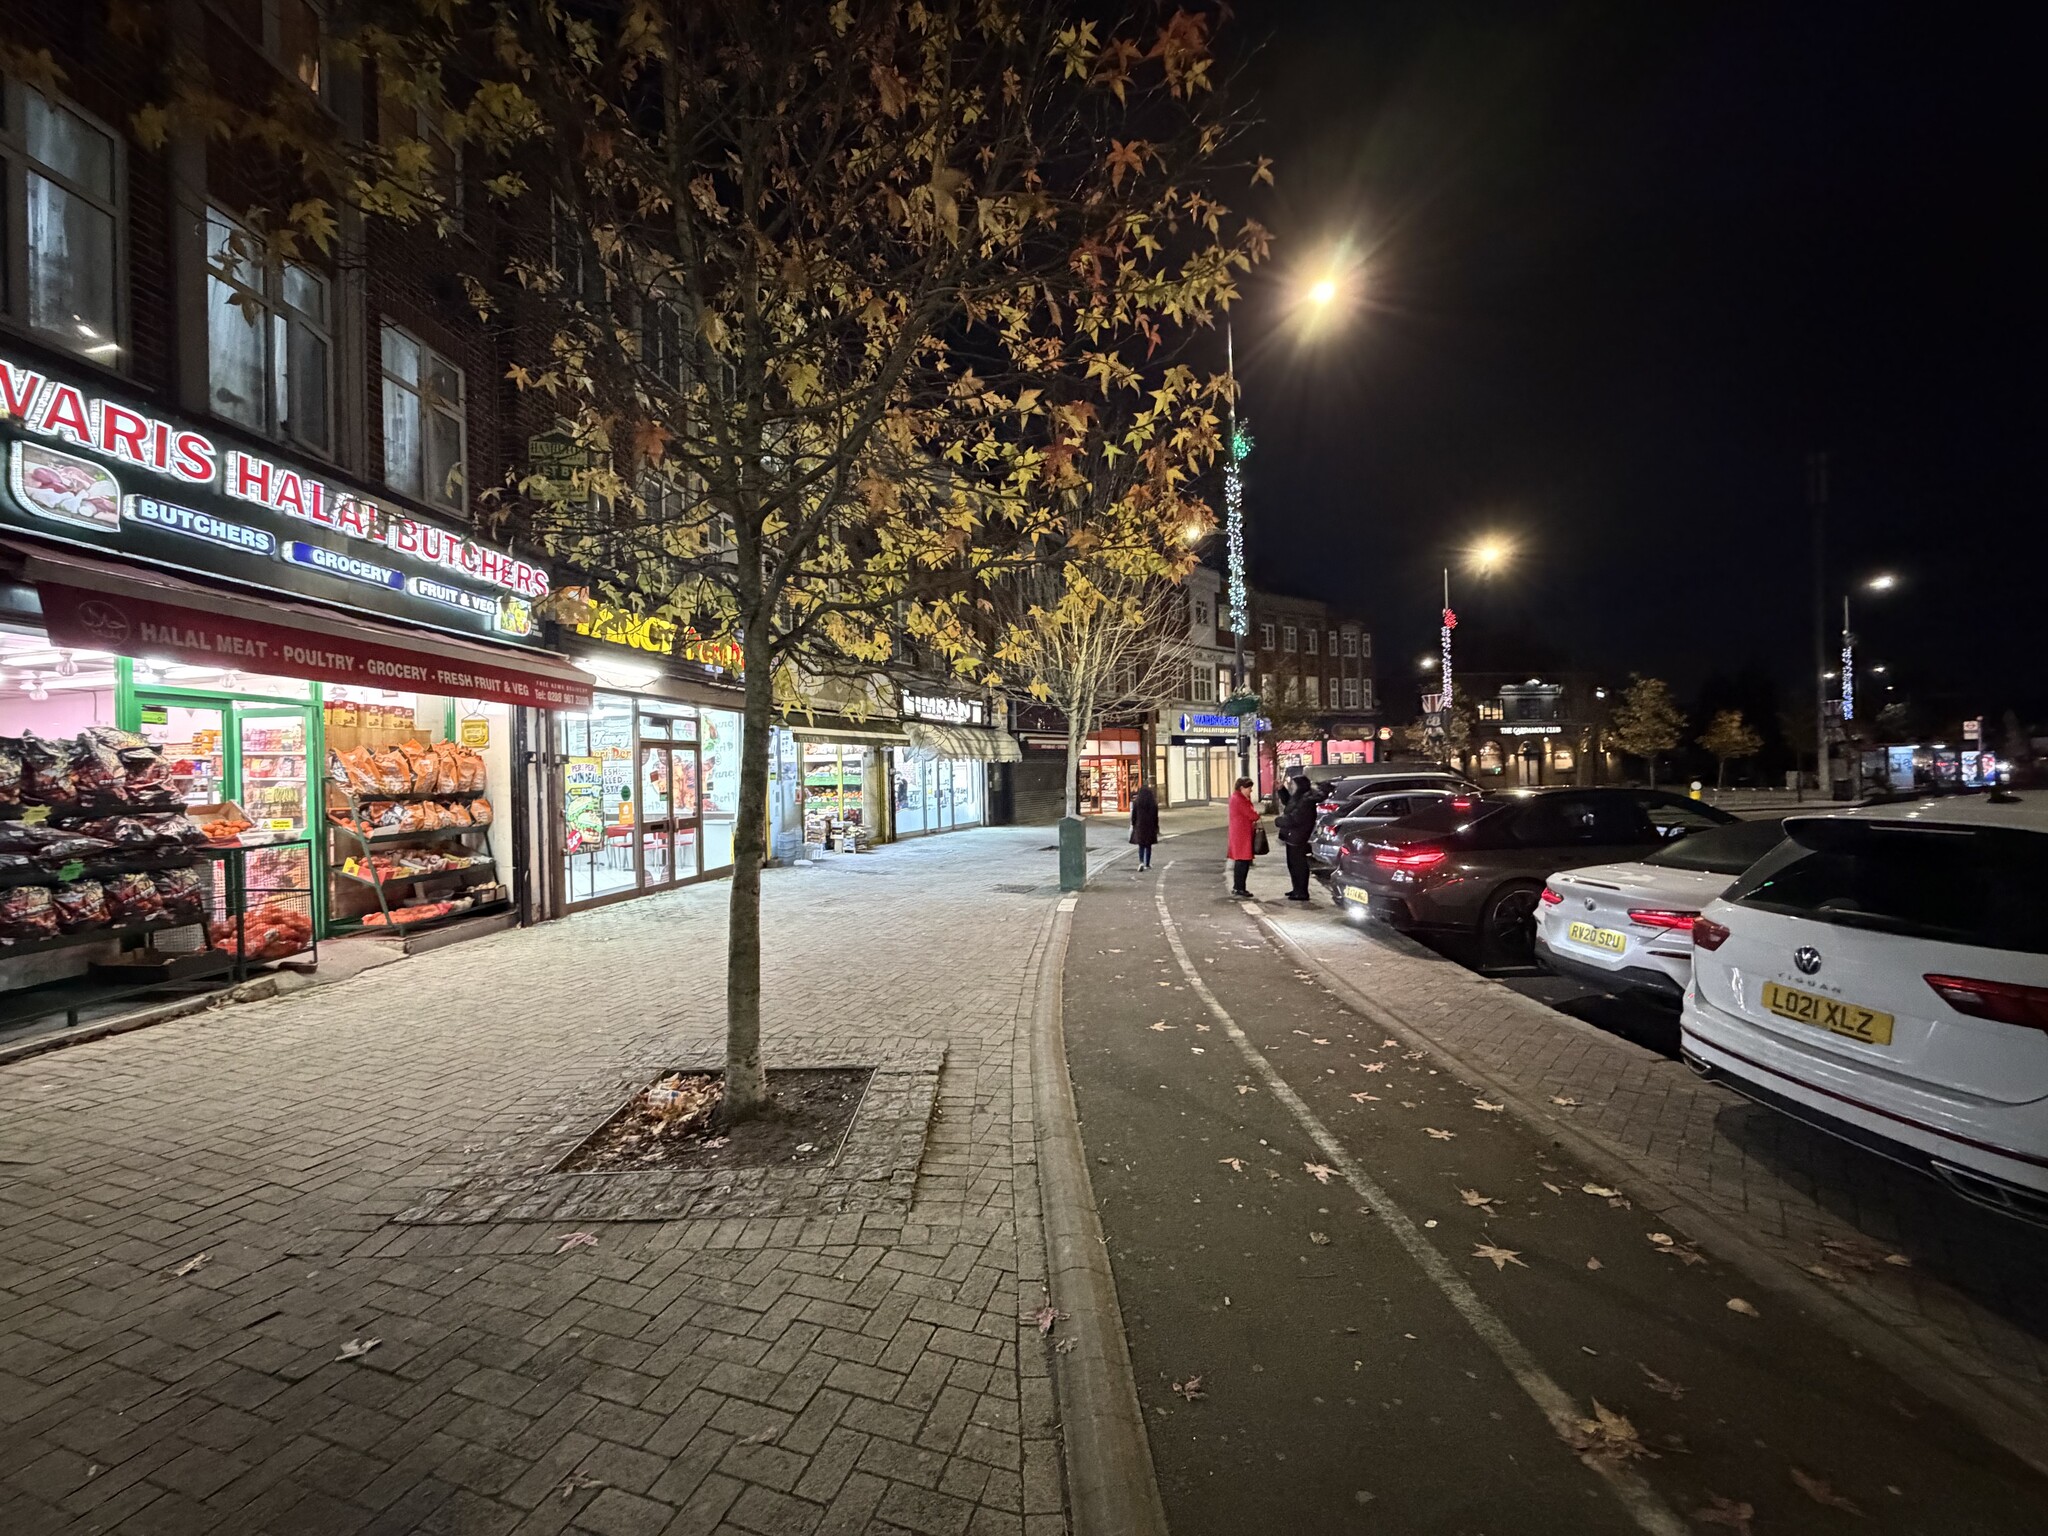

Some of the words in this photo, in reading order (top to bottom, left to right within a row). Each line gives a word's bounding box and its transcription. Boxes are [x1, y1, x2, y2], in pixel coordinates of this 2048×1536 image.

[141, 499, 270, 551] BUTCHERS
[229, 451, 389, 545] HALAL
[395, 518, 550, 598] BUTCHERS
[312, 550, 393, 583] GROCERY
[419, 580, 458, 605] FRUIT
[460, 591, 470, 607] &
[472, 597, 496, 614] VEG
[140, 622, 212, 650] HALAL
[216, 634, 268, 658] MEAT
[283, 645, 355, 671] POULTRY
[367, 659, 428, 681] GROCERY
[437, 670, 473, 687] FRESH
[474, 676, 502, 692] FRUIT
[503, 681, 511, 693] &
[512, 683, 530, 696] VEG
[1546, 726, 1561, 734] CLUB
[1825, 1002, 1874, 1036] XLZ
